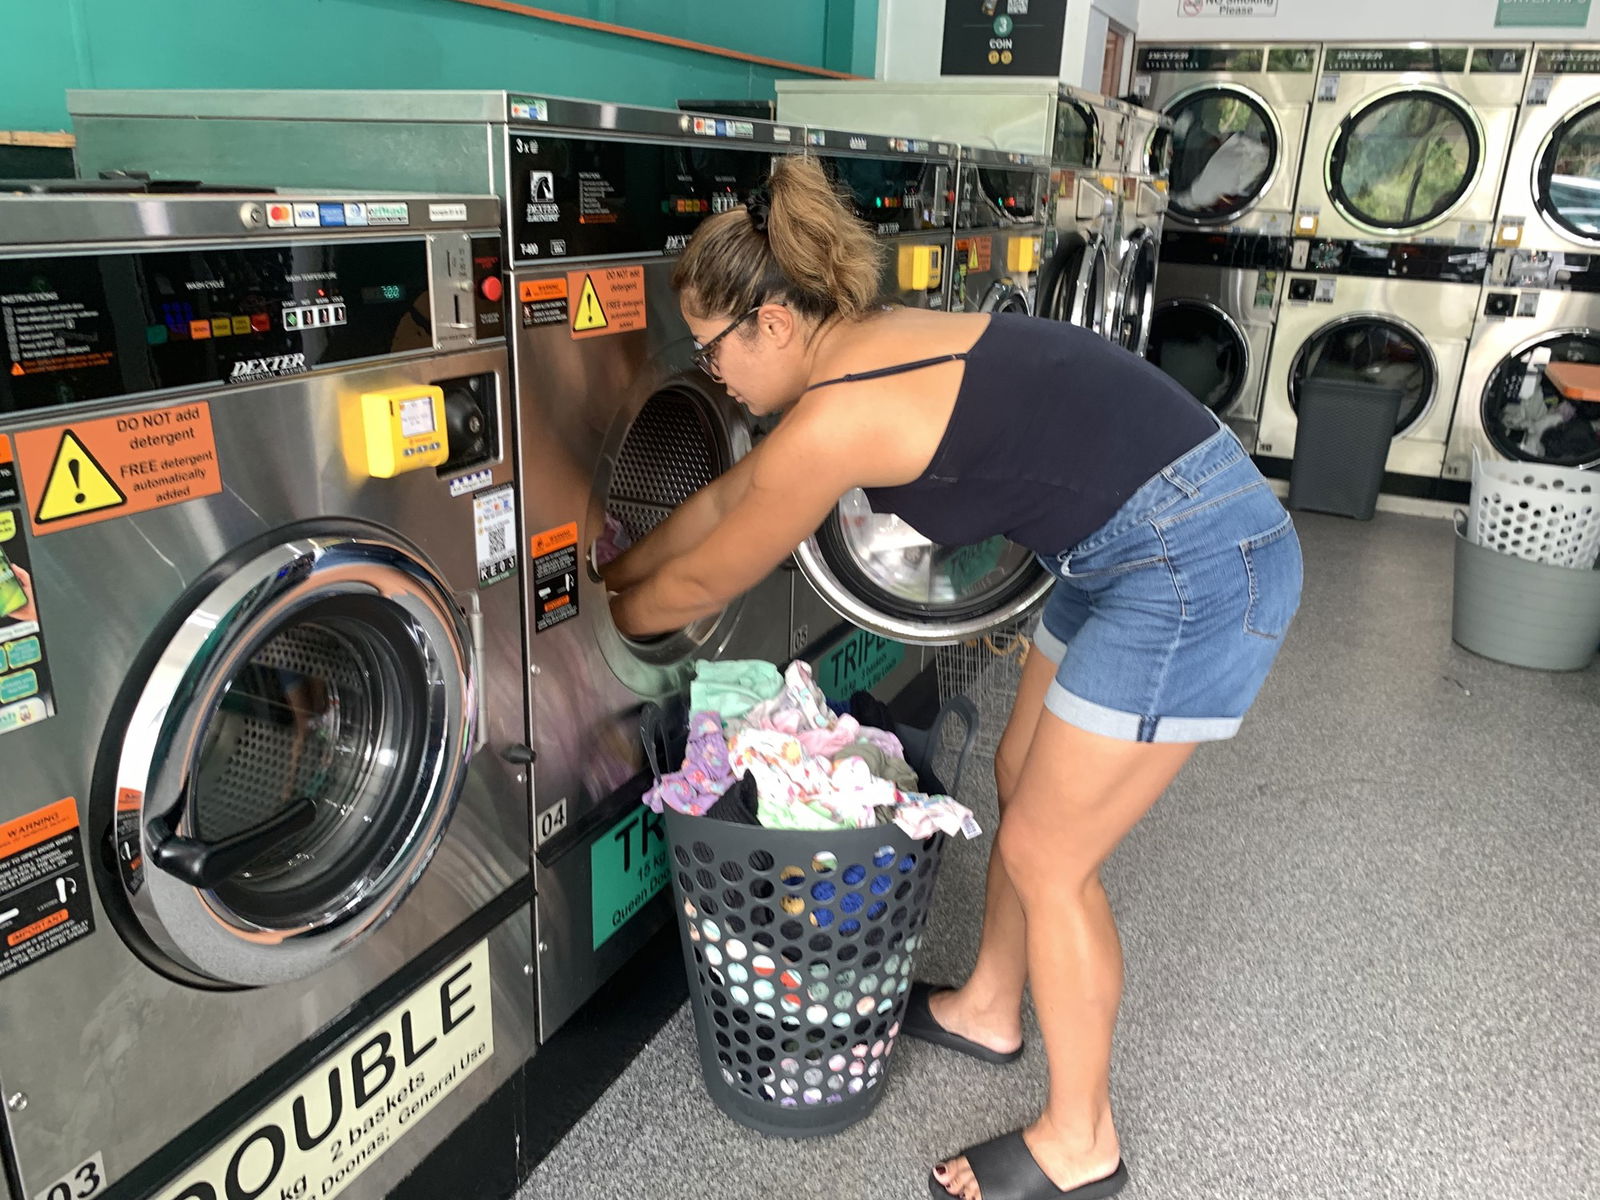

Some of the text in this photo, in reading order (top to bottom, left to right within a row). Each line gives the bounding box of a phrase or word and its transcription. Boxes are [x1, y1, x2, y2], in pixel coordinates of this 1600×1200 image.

[1219, 6, 1253, 16] Please
[999, 17, 1008, 33] 3
[989, 39, 1013, 50] COIN
[230, 353, 305, 377] DEXTER
[117, 408, 200, 433] DO NOT add
[130, 427, 196, 450] detergent
[120, 450, 213, 479] FREE detergent
[133, 467, 206, 493] automatically
[155, 486, 191, 503] added
[831, 631, 891, 688] TRIPL
[8, 812, 59, 839] WARNING
[542, 803, 565, 837] 04
[615, 810, 664, 873] TR
[612, 866, 672, 927] Queen Doo
[321, 1040, 487, 1196] Doonas; General Use
[280, 1070, 425, 1200] kg 2 baskets
